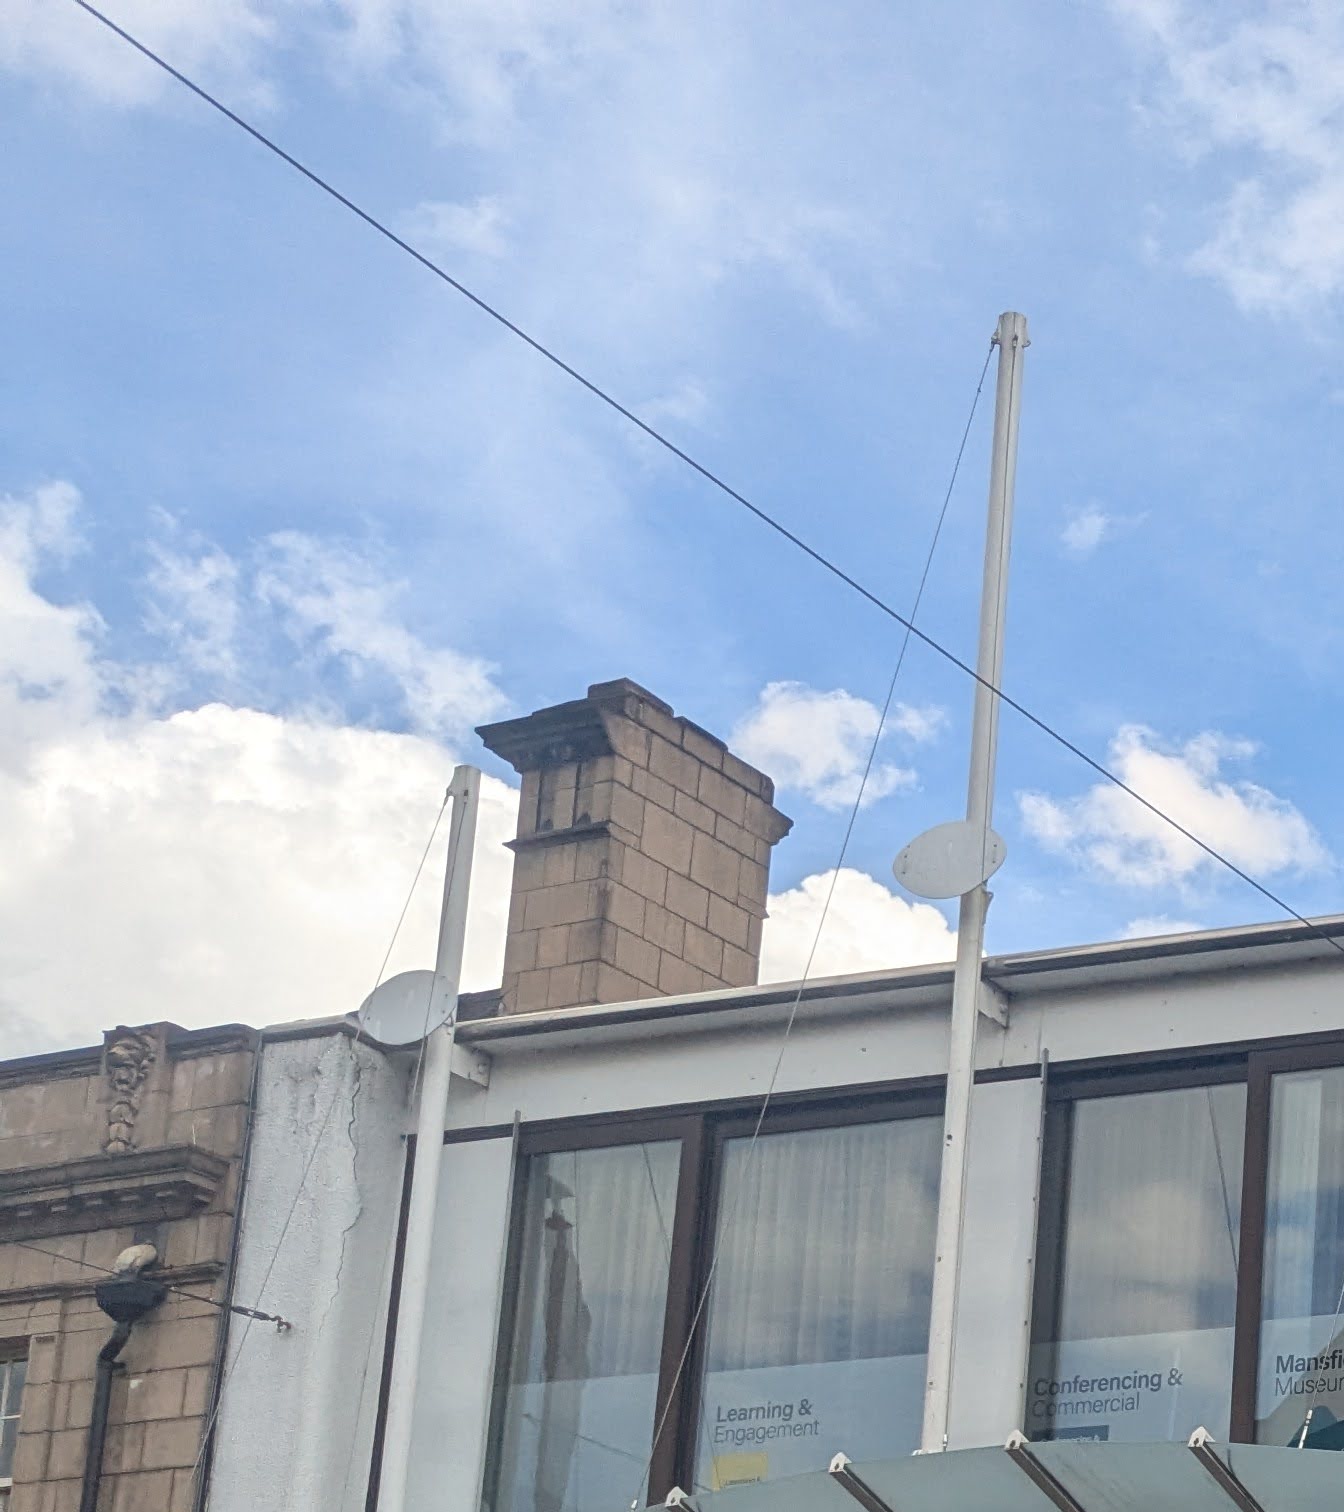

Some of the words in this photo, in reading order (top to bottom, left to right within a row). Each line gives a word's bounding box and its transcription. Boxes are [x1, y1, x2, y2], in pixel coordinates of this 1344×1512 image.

[1033, 1368, 1163, 1398] Conferencing
[1166, 1368, 1183, 1388] &
[716, 1402, 794, 1427] Learning
[797, 1399, 813, 1418] &
[1031, 1393, 1140, 1417] Commercial
[713, 1418, 819, 1446] Engagement
